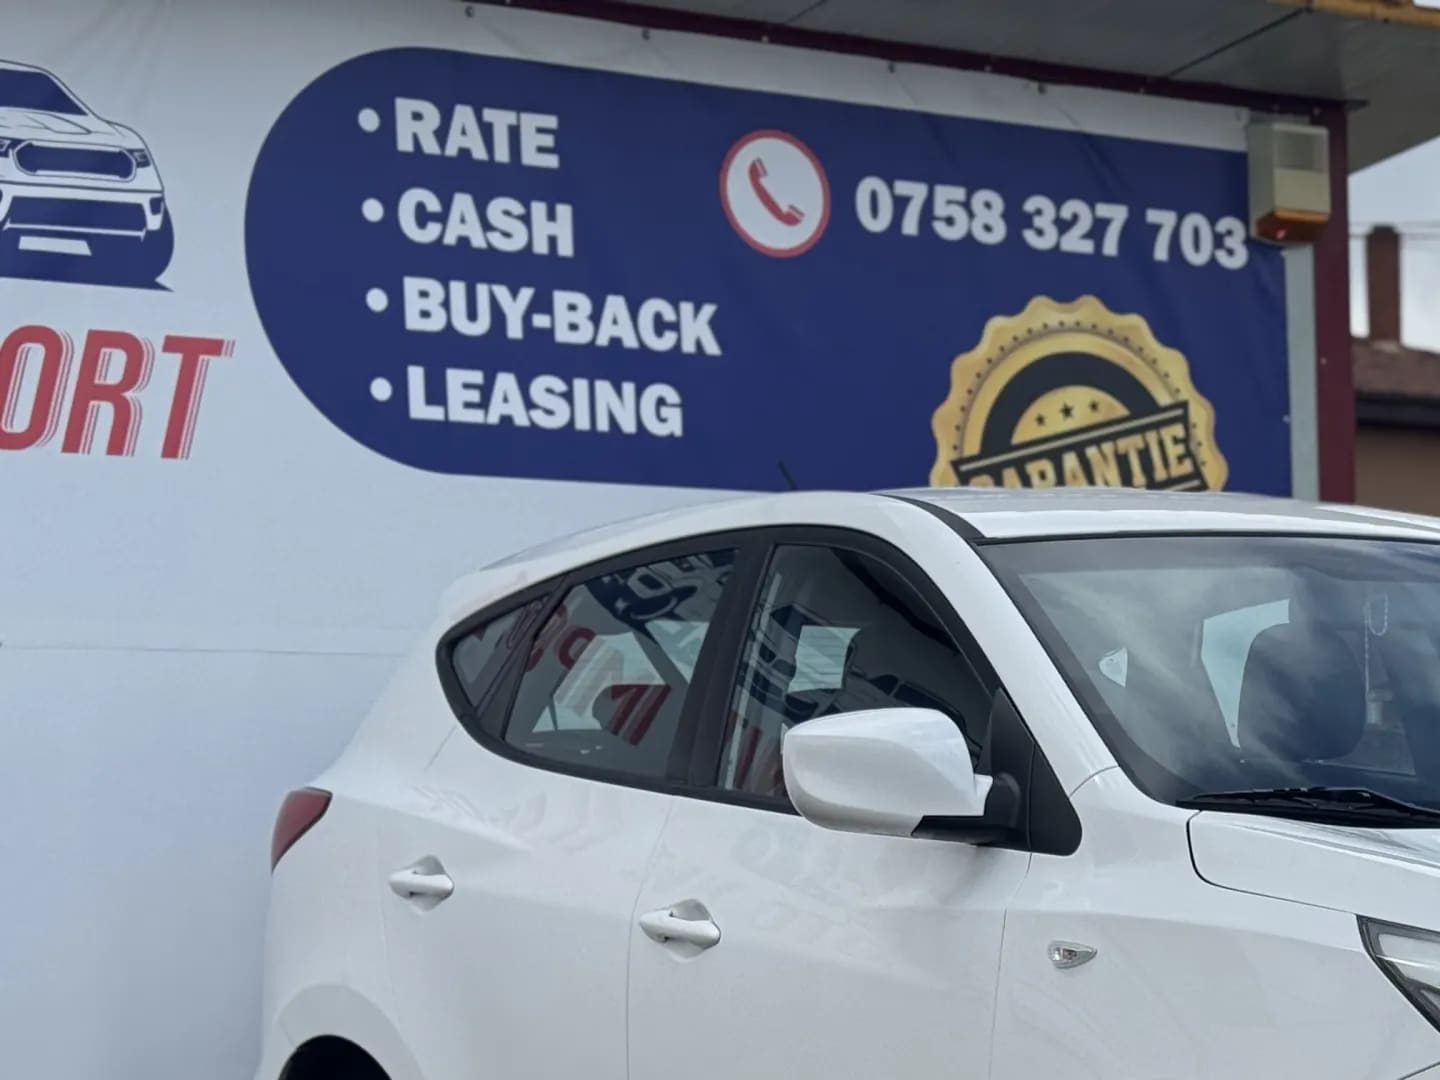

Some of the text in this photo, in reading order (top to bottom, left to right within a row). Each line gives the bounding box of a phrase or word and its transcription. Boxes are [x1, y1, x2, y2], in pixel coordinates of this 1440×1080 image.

[395, 97, 560, 169] RATE
[398, 188, 575, 257] CASH
[855, 175, 1249, 271] 0758 327 703
[403, 276, 722, 356] BUY-BACK
[407, 365, 684, 437] LEASING
